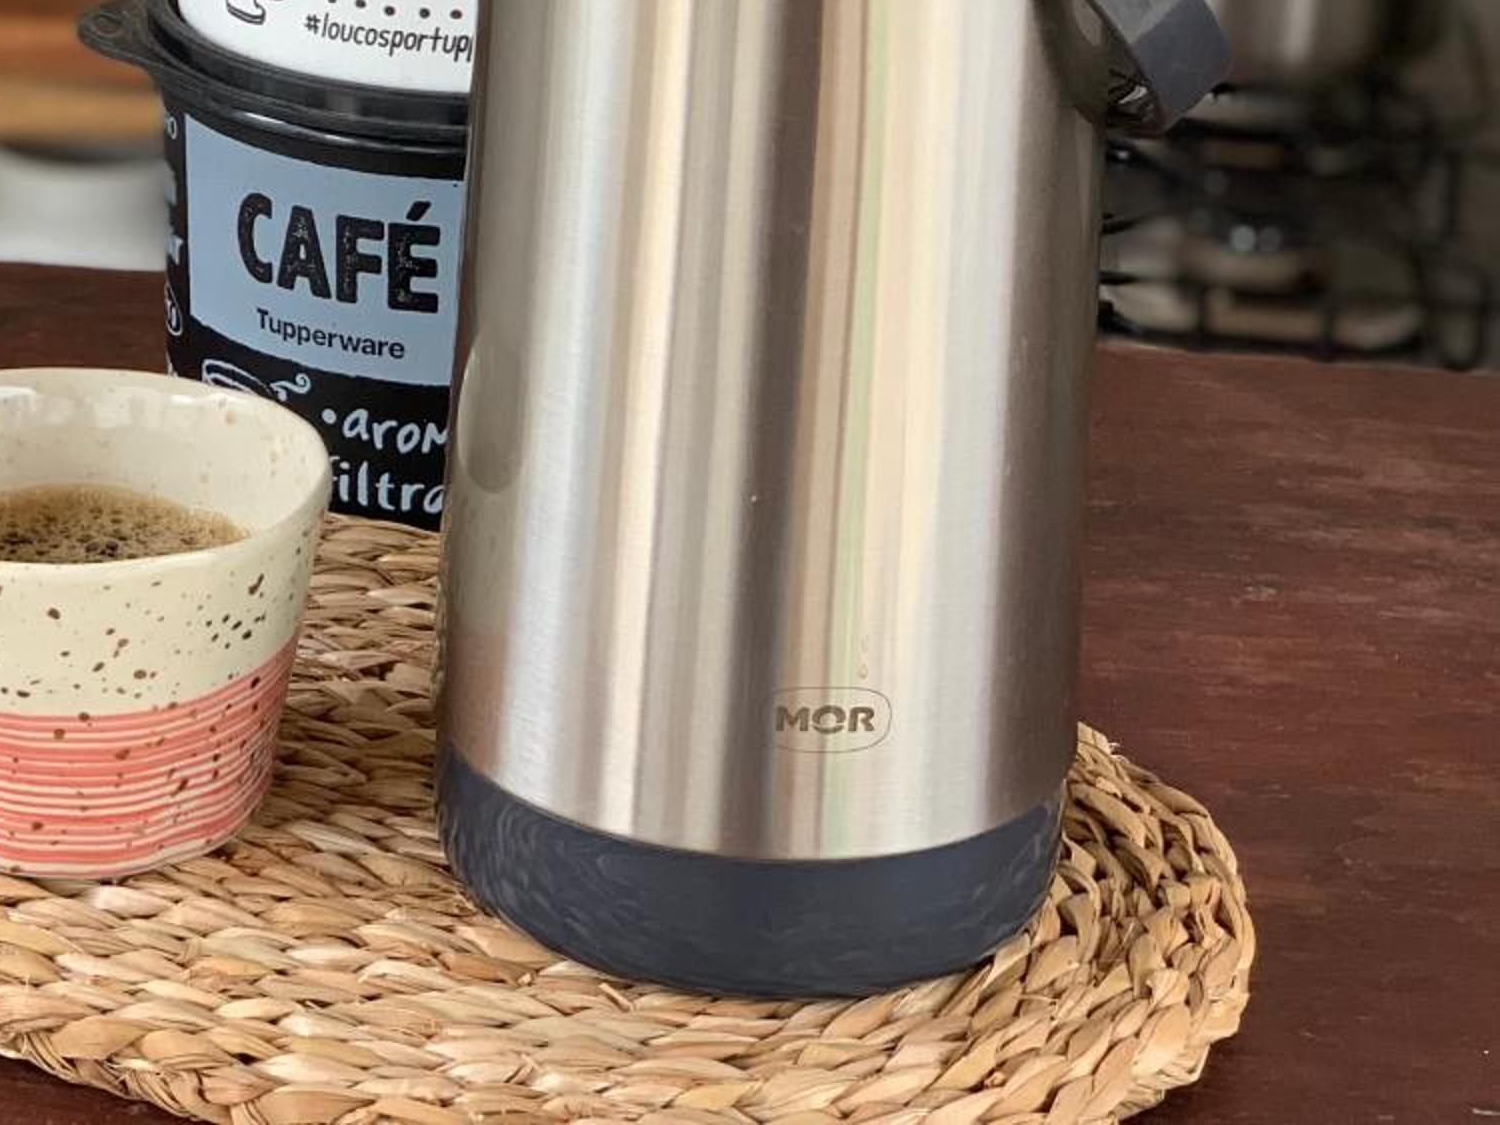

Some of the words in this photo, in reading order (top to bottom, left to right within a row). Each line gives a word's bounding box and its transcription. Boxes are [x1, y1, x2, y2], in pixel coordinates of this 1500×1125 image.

[304, 12, 473, 62] #loucosportup
[237, 192, 441, 313] CAFÉ
[256, 308, 405, 359] Tupperware
[775, 705, 876, 733] MOR
